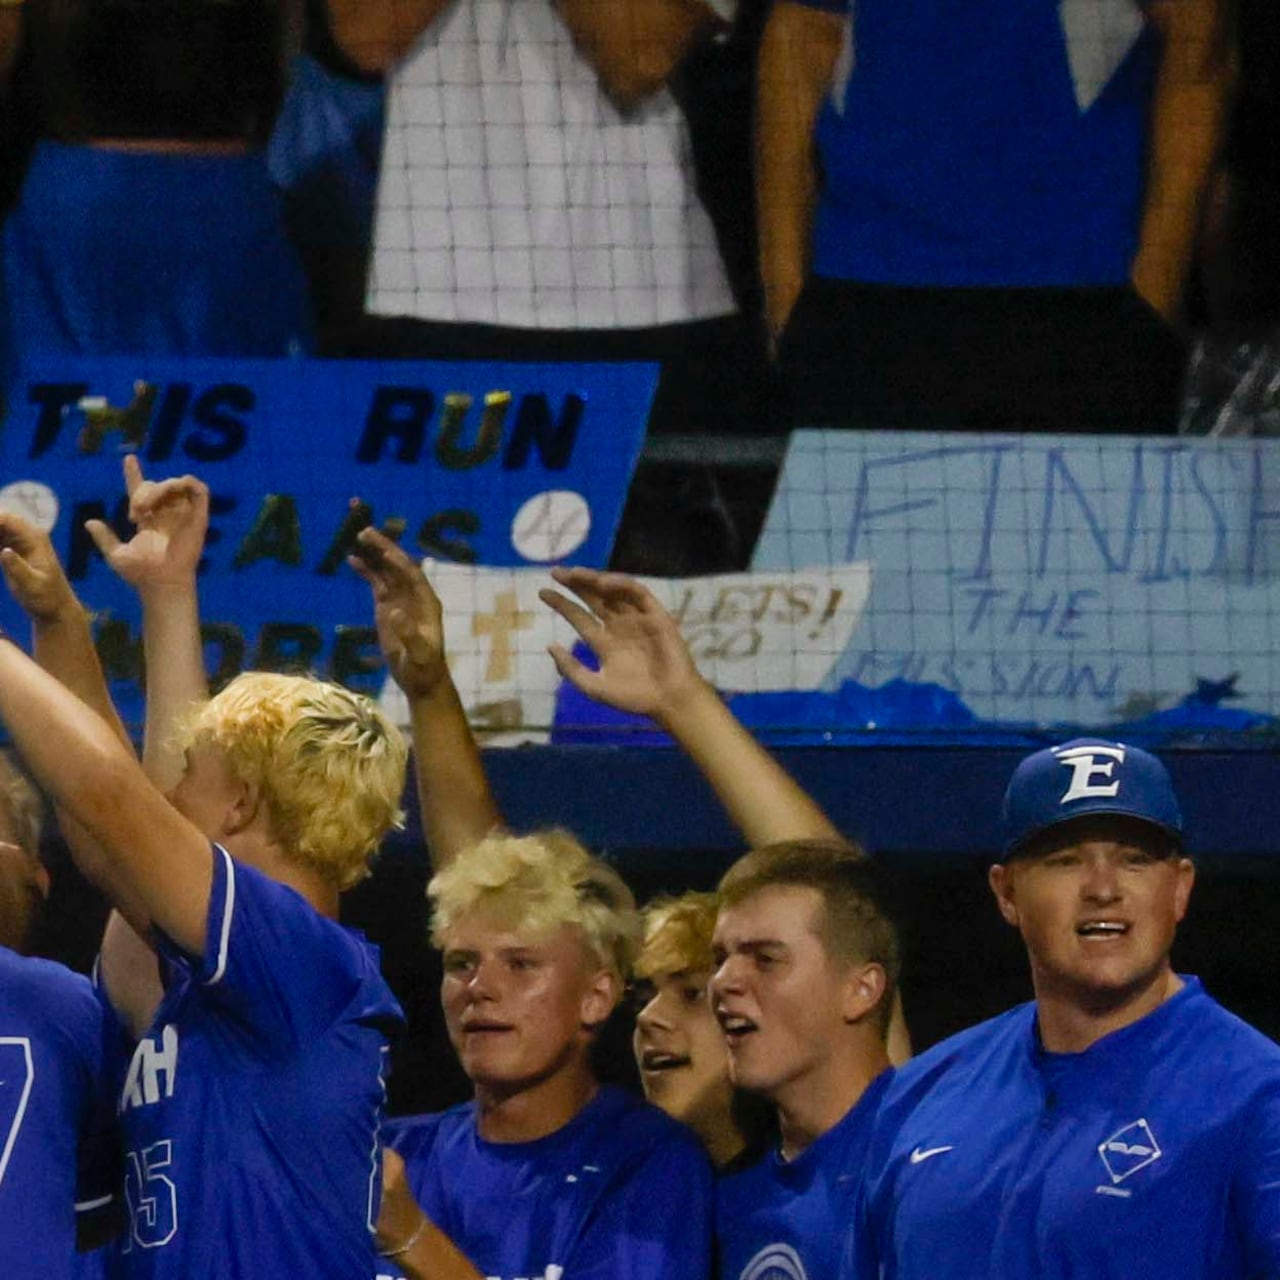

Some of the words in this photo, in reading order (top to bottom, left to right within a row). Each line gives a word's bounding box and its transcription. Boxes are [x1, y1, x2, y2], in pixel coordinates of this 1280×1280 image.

[29, 379, 257, 463] THIS
[355, 386, 586, 471] RUN
[963, 589, 1101, 640] THE
[1054, 745, 1125, 804] E
